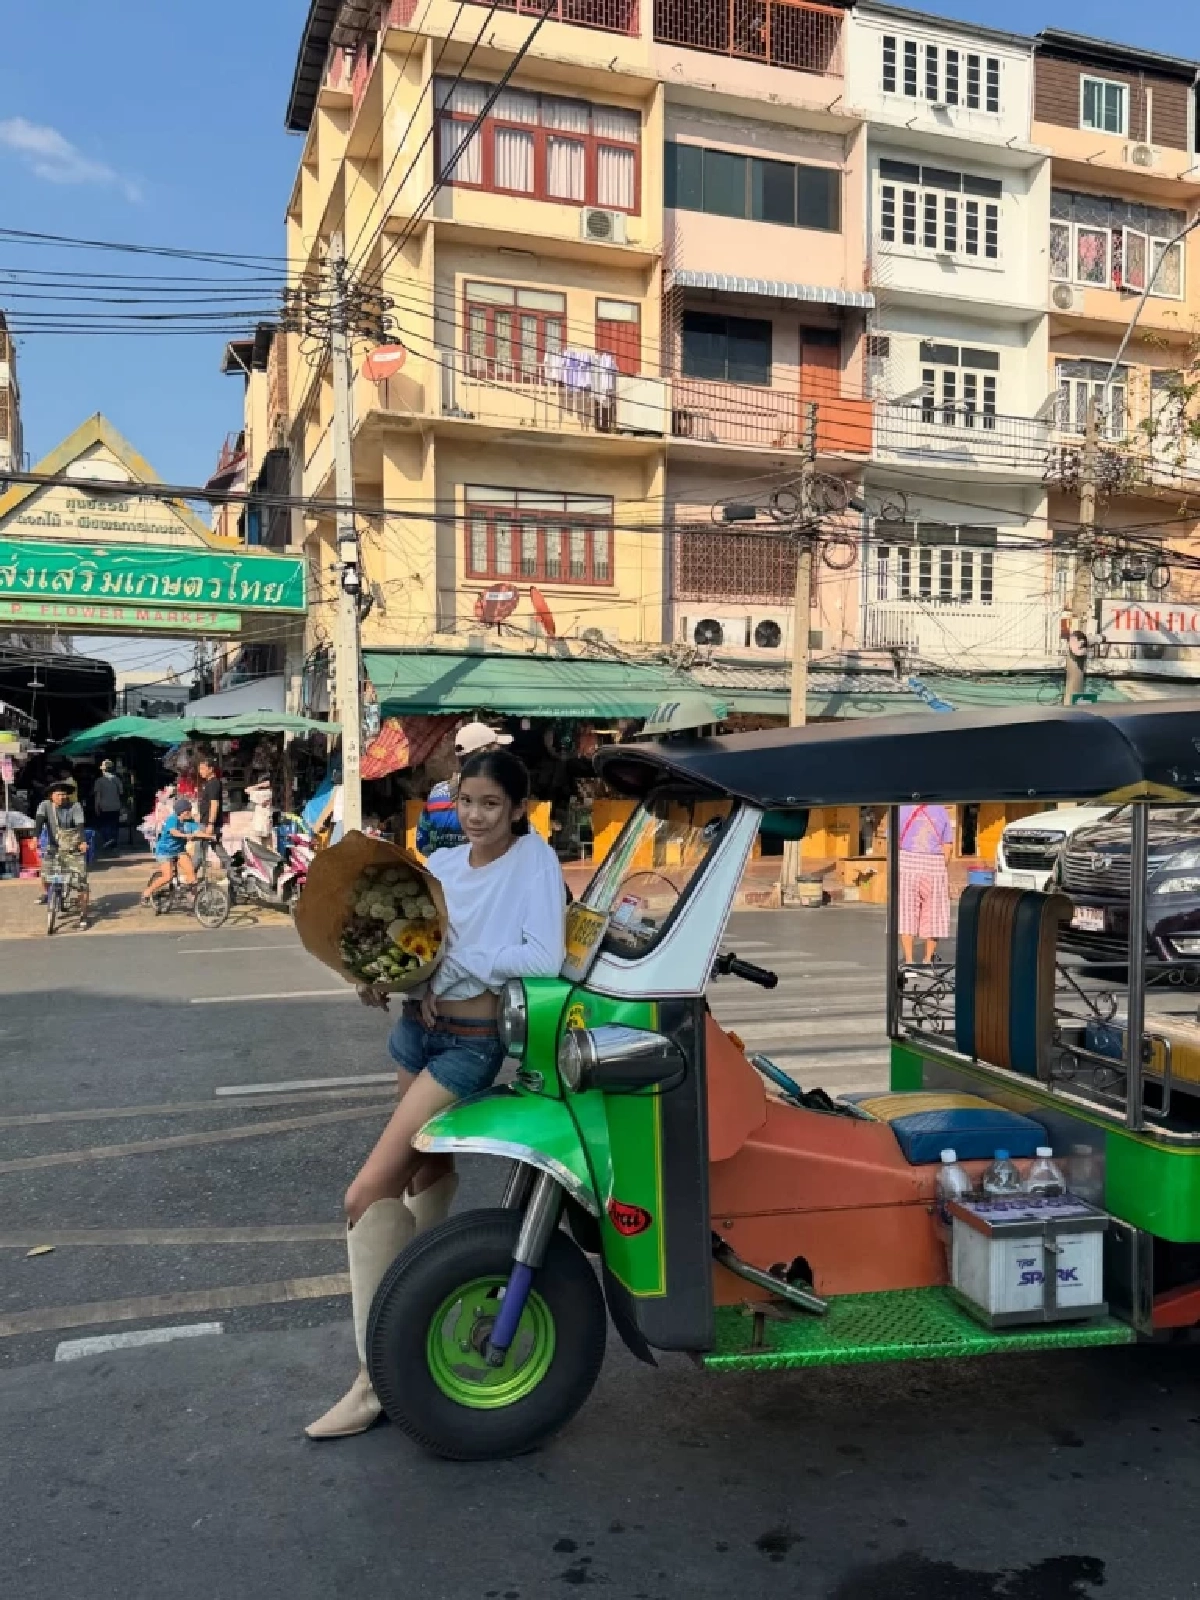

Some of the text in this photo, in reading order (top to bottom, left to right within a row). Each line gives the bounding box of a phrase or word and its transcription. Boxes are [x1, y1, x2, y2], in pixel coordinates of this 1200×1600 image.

[41, 604, 124, 620] FLOWER
[135, 609, 218, 623] MARKET
[1018, 1267, 1079, 1285] SPRK
